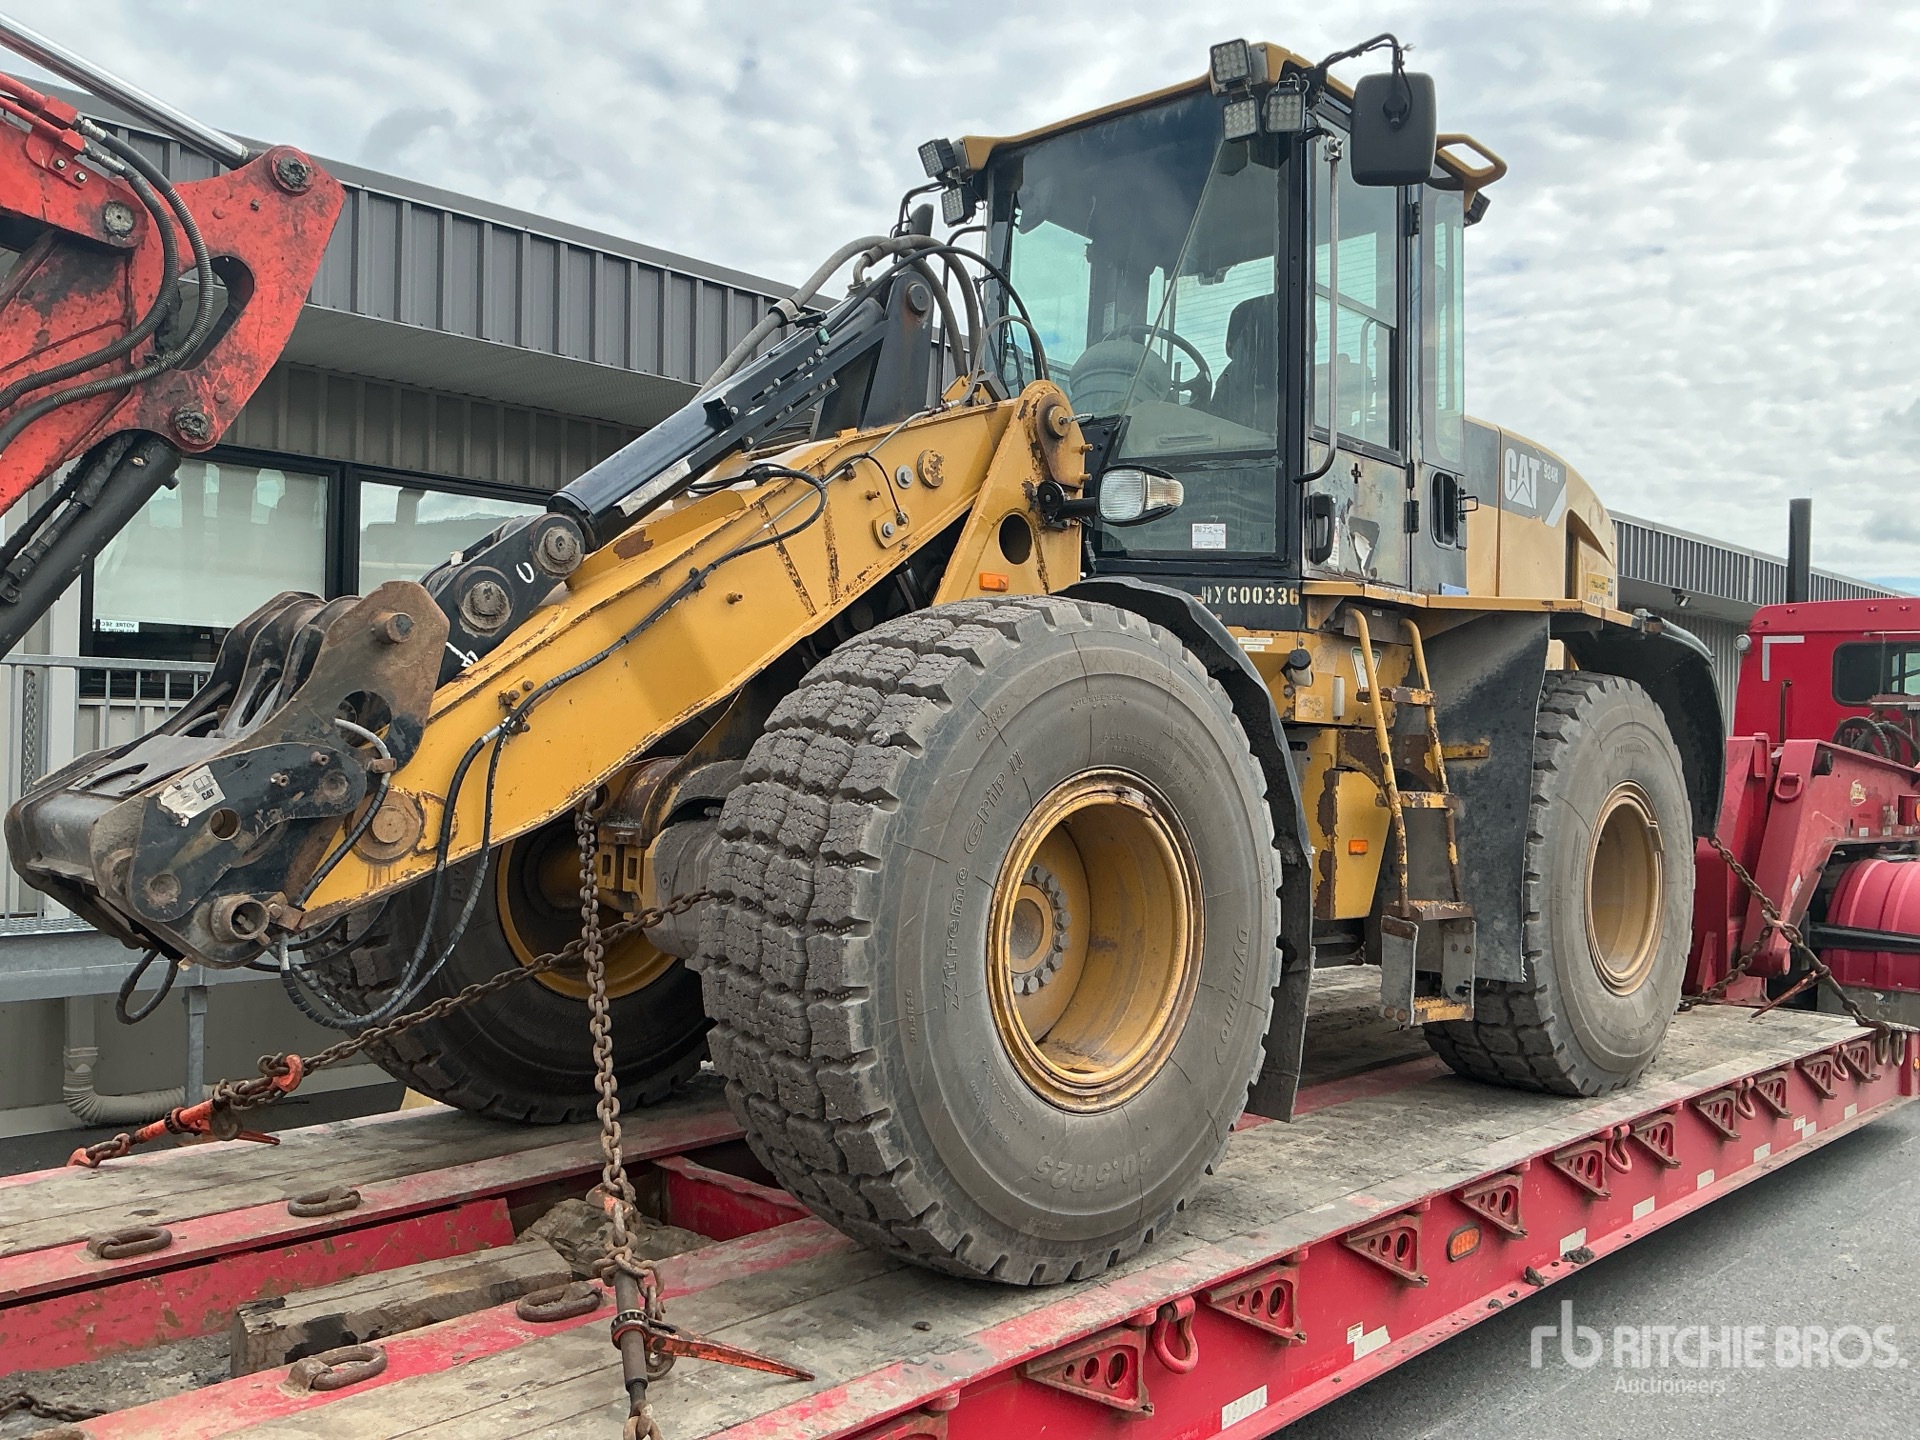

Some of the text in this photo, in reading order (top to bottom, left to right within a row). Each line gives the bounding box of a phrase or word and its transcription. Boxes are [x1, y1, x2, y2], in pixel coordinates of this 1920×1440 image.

[1504, 448, 1540, 509] CAT
[976, 704, 1007, 741] 20.5R25
[1125, 733, 1155, 751] STEEL
[201, 788, 215, 800] CAT
[943, 867, 969, 1013] Xtreme
[1219, 924, 1250, 1047] Dynamo
[906, 989, 917, 1043] 20.5R25
